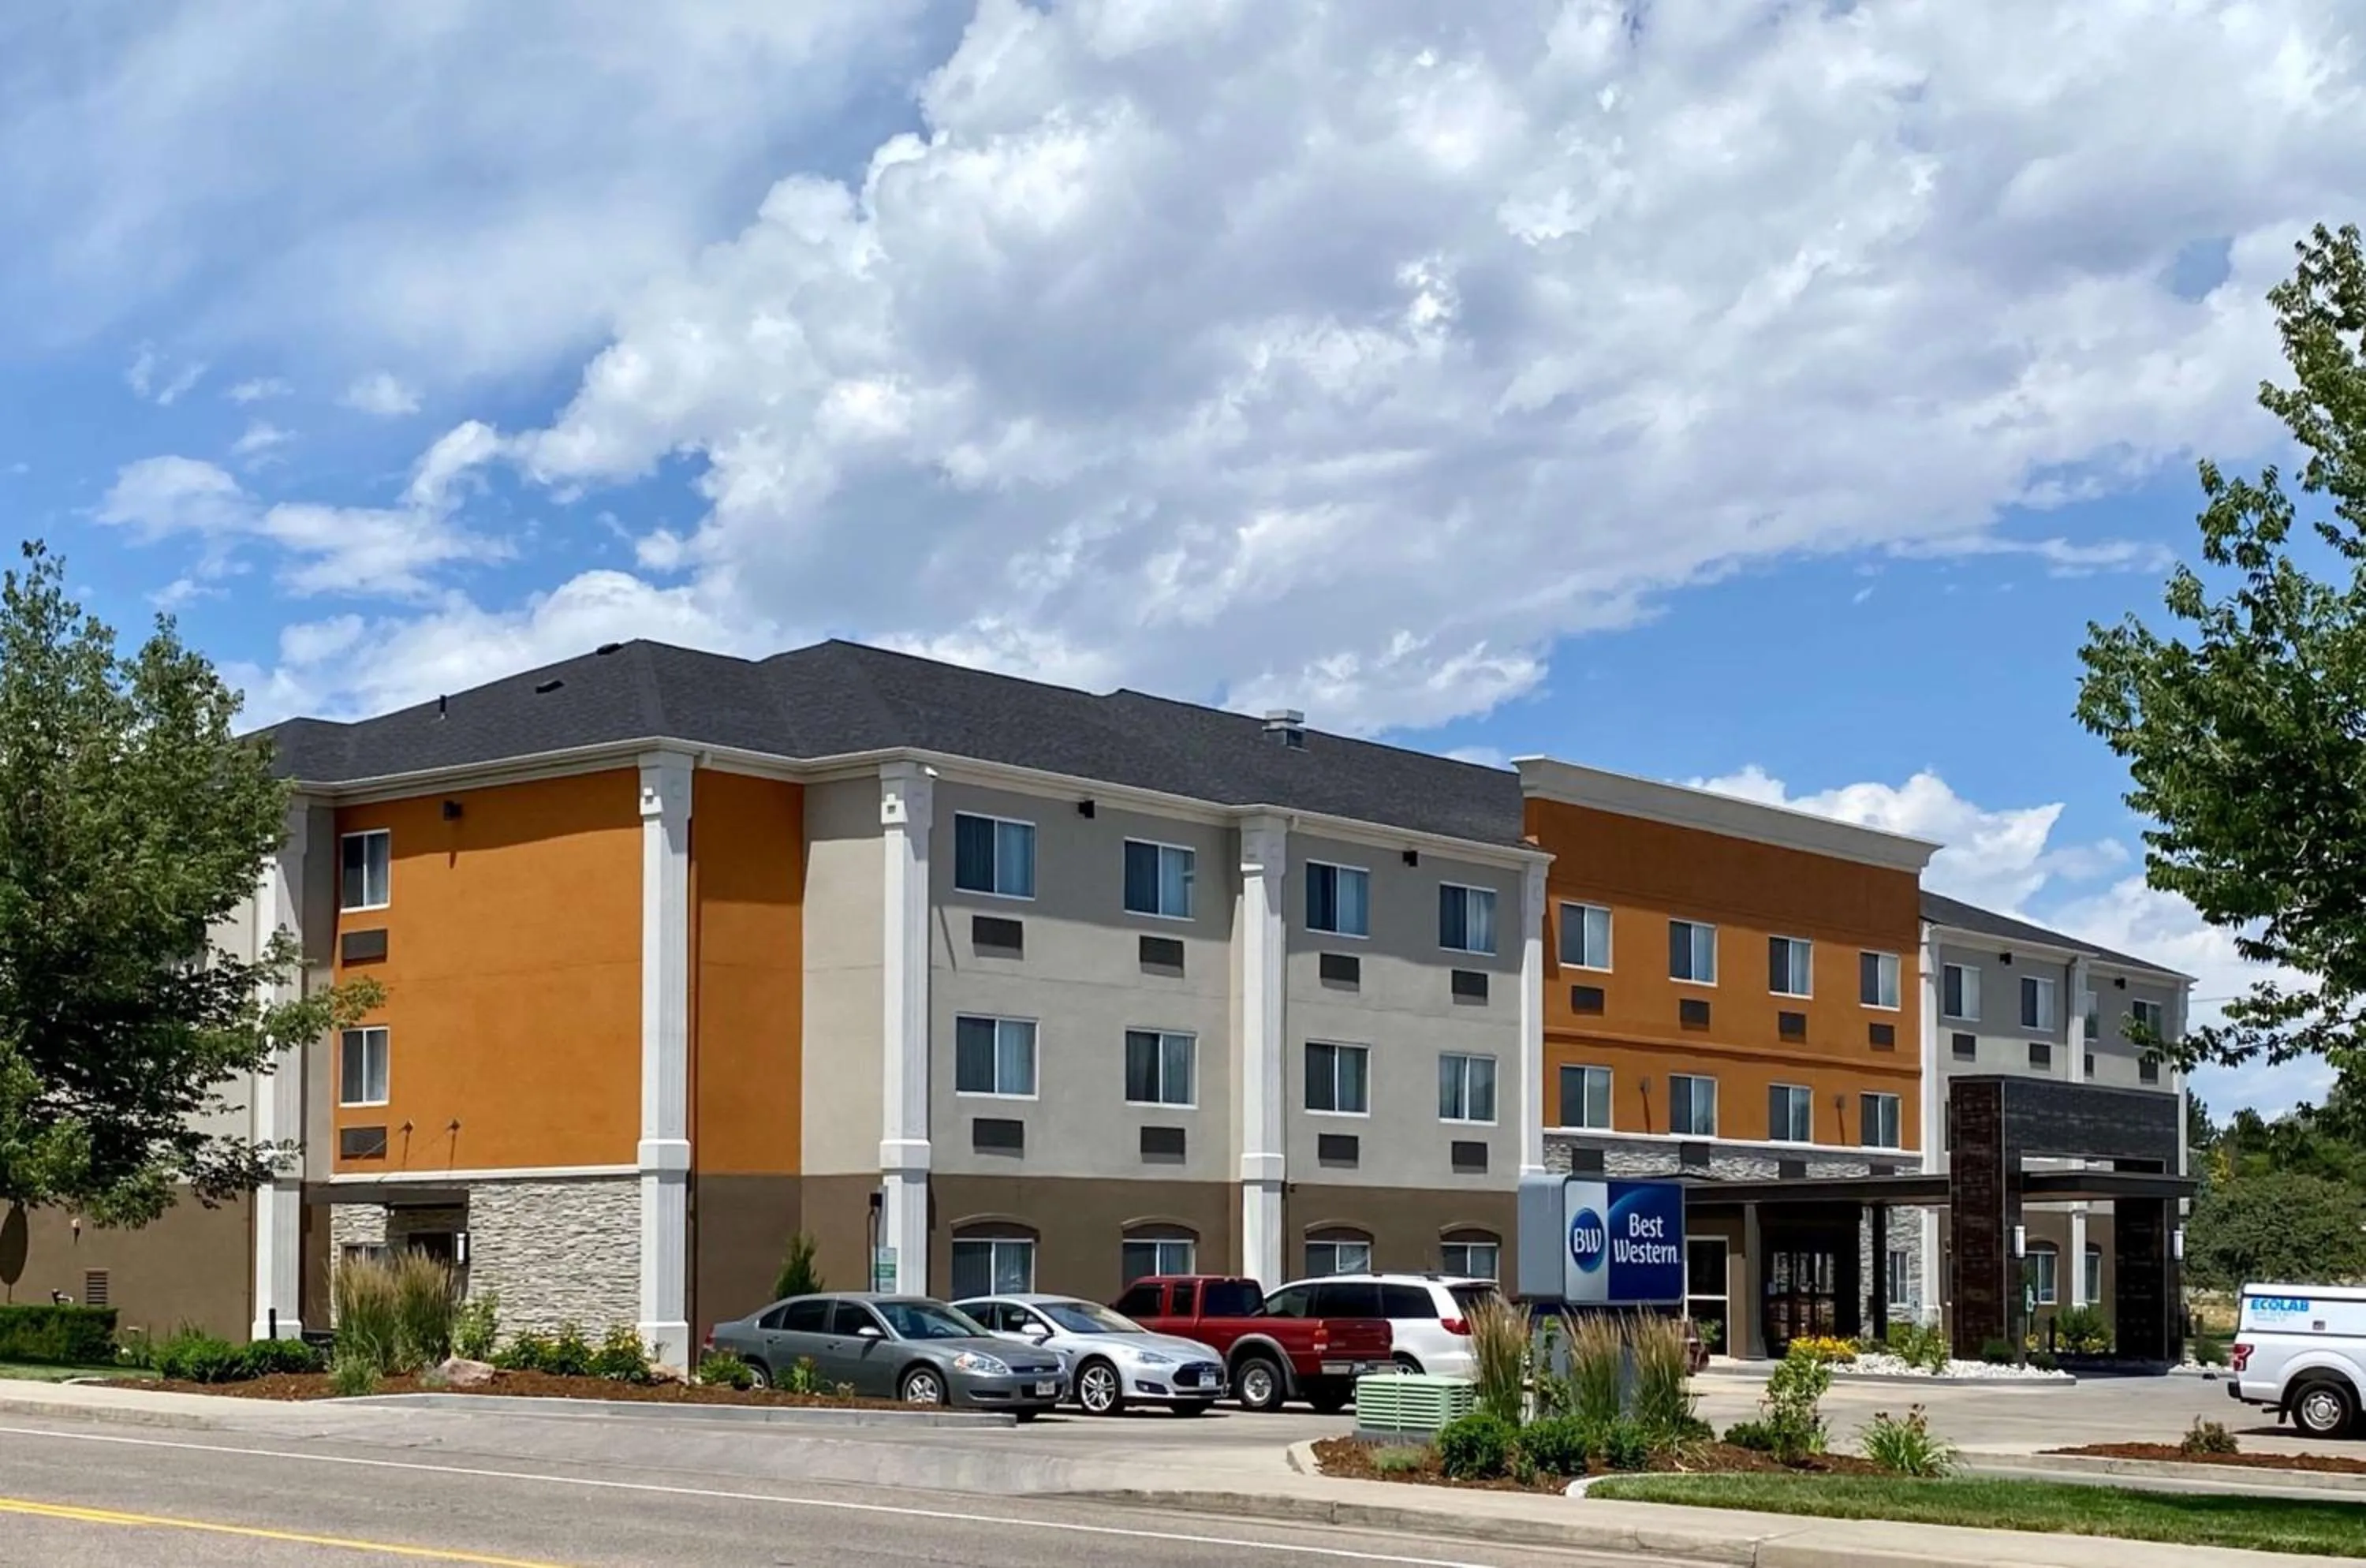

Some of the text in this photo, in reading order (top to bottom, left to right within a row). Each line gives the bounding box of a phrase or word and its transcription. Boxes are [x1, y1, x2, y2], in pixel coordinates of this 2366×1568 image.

[1629, 1213, 1663, 1238] Best
[1573, 1228, 1602, 1253] BW
[1613, 1238, 1678, 1264] Western
[2251, 1298, 2309, 1312] ECOLAB
